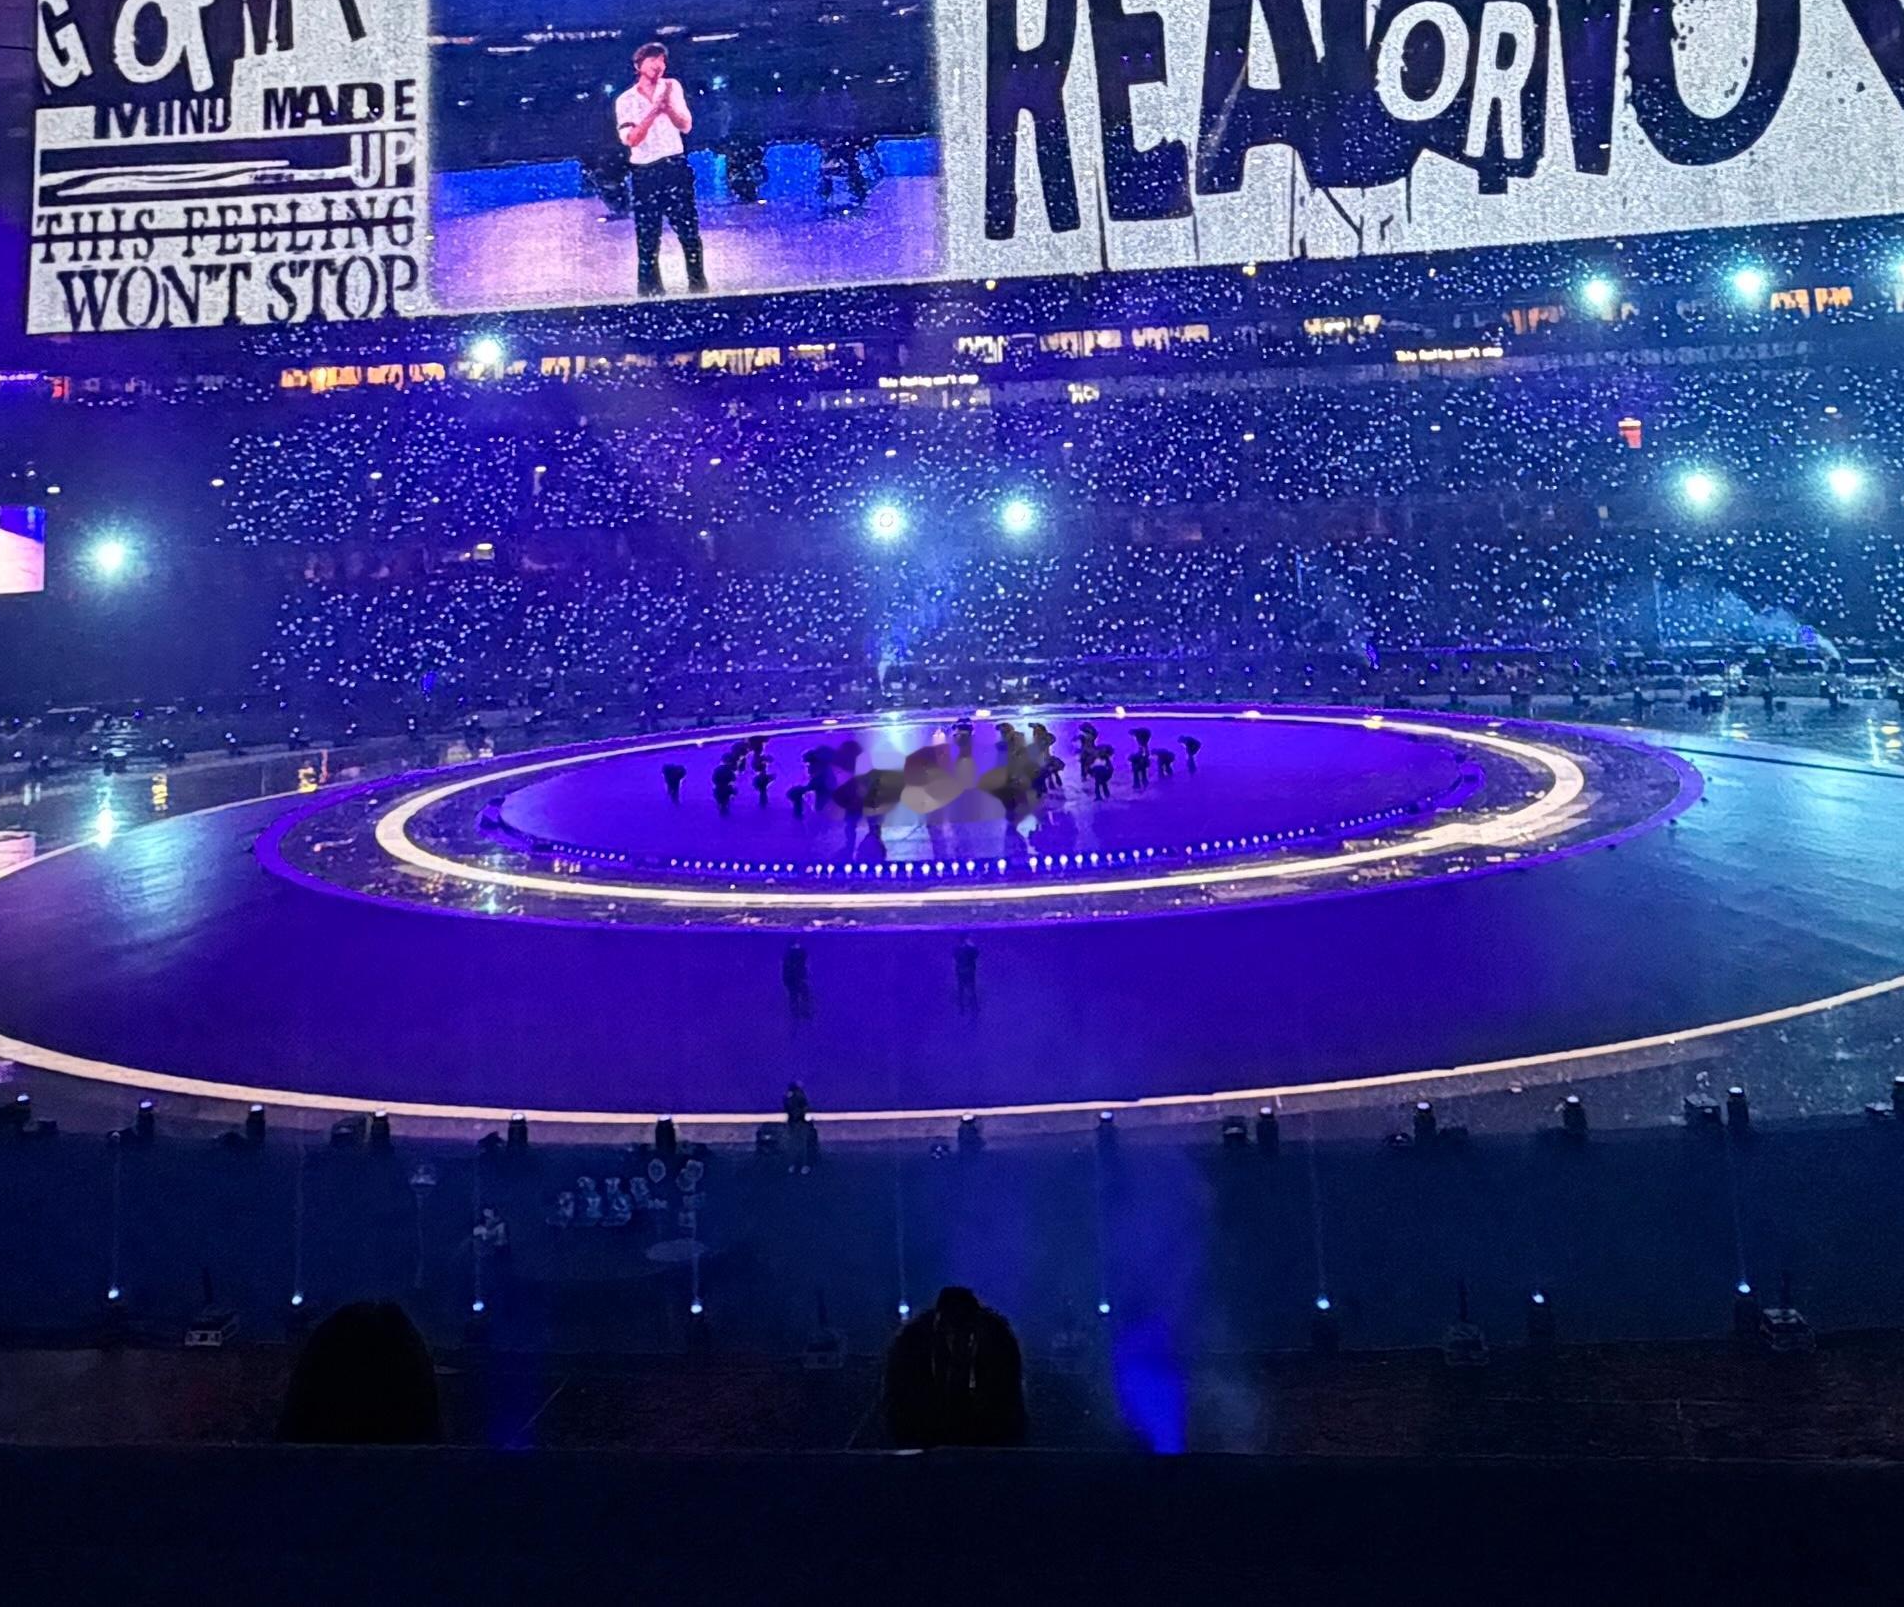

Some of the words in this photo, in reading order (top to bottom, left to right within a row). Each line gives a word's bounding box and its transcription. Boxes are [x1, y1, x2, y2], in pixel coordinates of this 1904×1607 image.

[263, 78, 417, 131] MADE
[1375, 0, 1538, 161] OR
[349, 131, 416, 190] UP
[36, 209, 156, 264] THIS
[181, 196, 415, 257] FEELING
[267, 254, 419, 326] STOP
